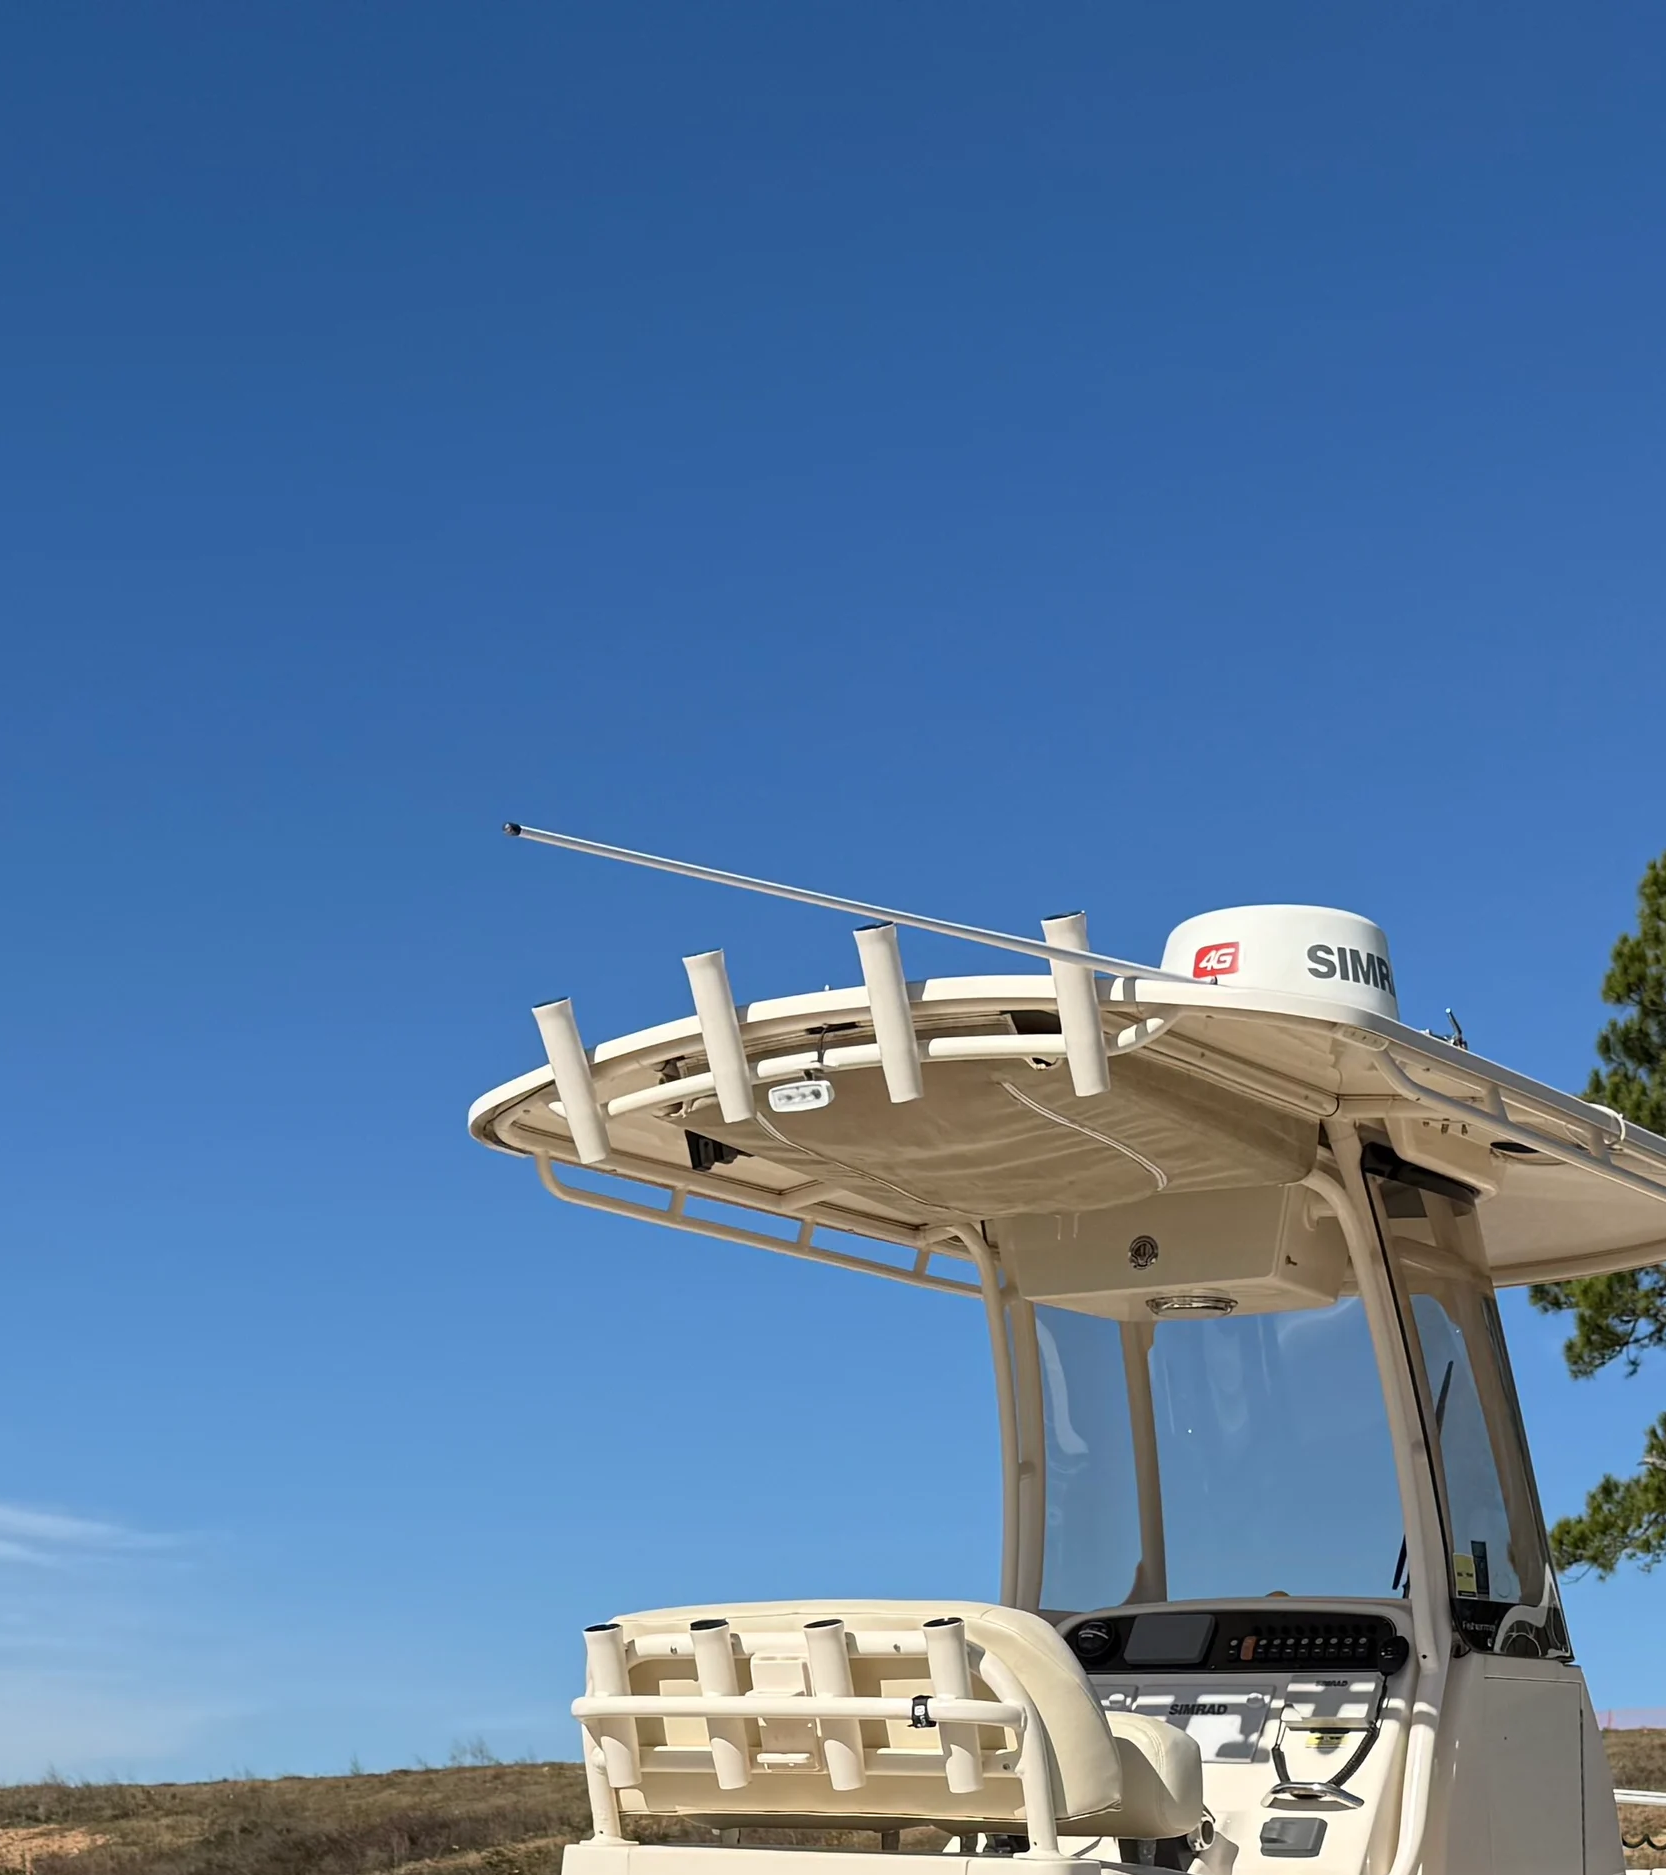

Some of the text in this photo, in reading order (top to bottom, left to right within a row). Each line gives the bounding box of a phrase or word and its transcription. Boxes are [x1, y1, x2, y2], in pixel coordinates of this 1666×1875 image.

[1198, 948, 1236, 971] 4G
[1306, 944, 1396, 998] SIMR
[1168, 1703, 1228, 1715] SIMRAD
